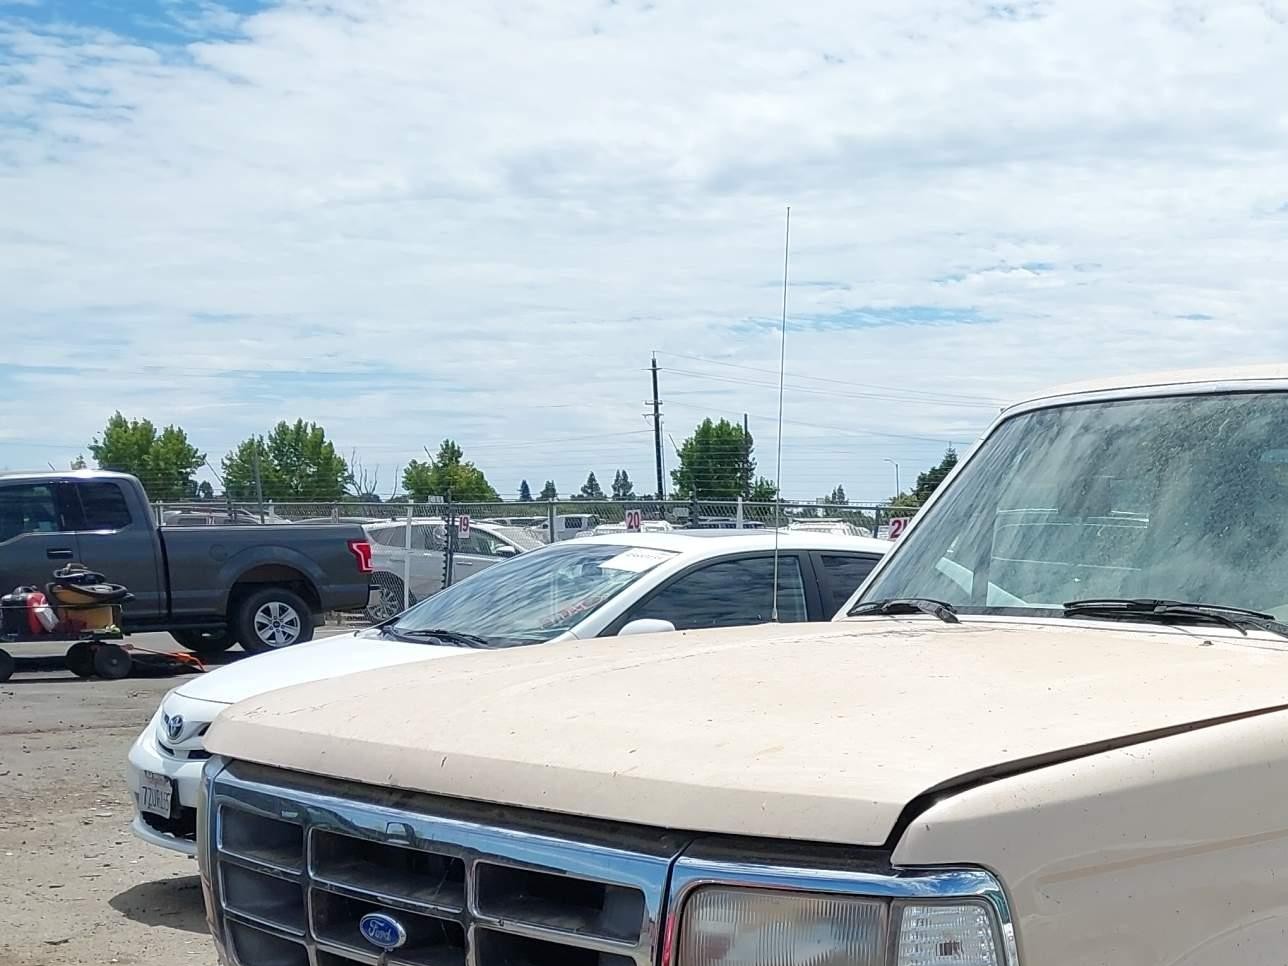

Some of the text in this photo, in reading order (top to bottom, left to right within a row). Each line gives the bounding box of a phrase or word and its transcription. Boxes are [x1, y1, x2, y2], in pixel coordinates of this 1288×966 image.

[460, 516, 469, 532] 19
[627, 511, 640, 529] 20
[367, 919, 393, 942] Ford
